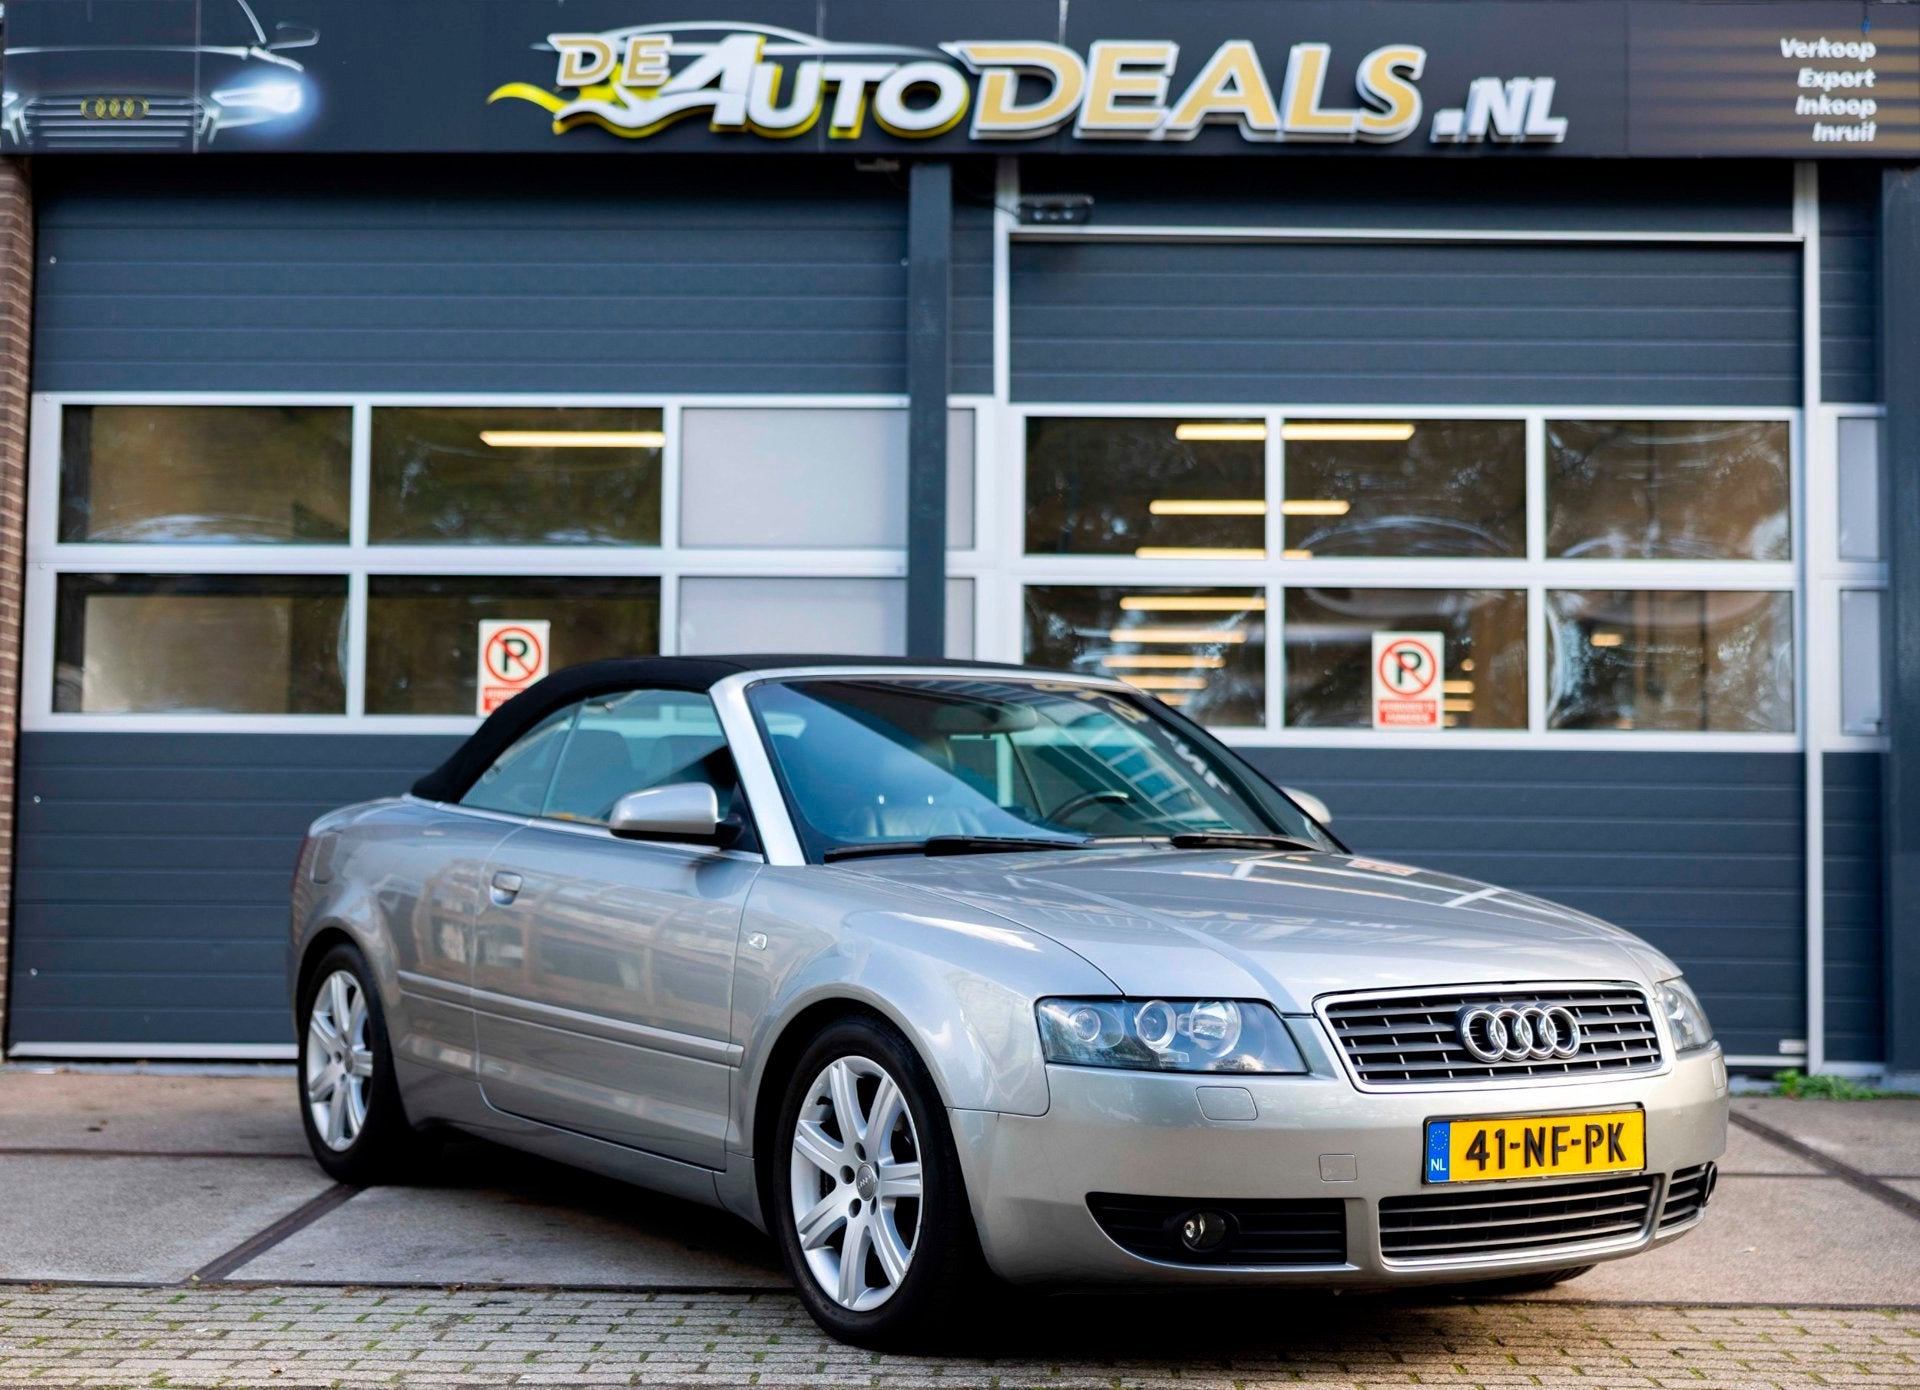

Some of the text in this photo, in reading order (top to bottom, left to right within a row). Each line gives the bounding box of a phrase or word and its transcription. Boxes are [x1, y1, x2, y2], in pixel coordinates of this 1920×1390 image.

[548, 33, 672, 87] DE
[1780, 37, 1877, 62] Verkoop
[1797, 67, 1876, 92] Export
[1795, 94, 1878, 120] Inkoop
[1811, 121, 1877, 142] Inruil
[1465, 1121, 1627, 1171] 41-NF-PK
[1430, 1158, 1447, 1172] NL
